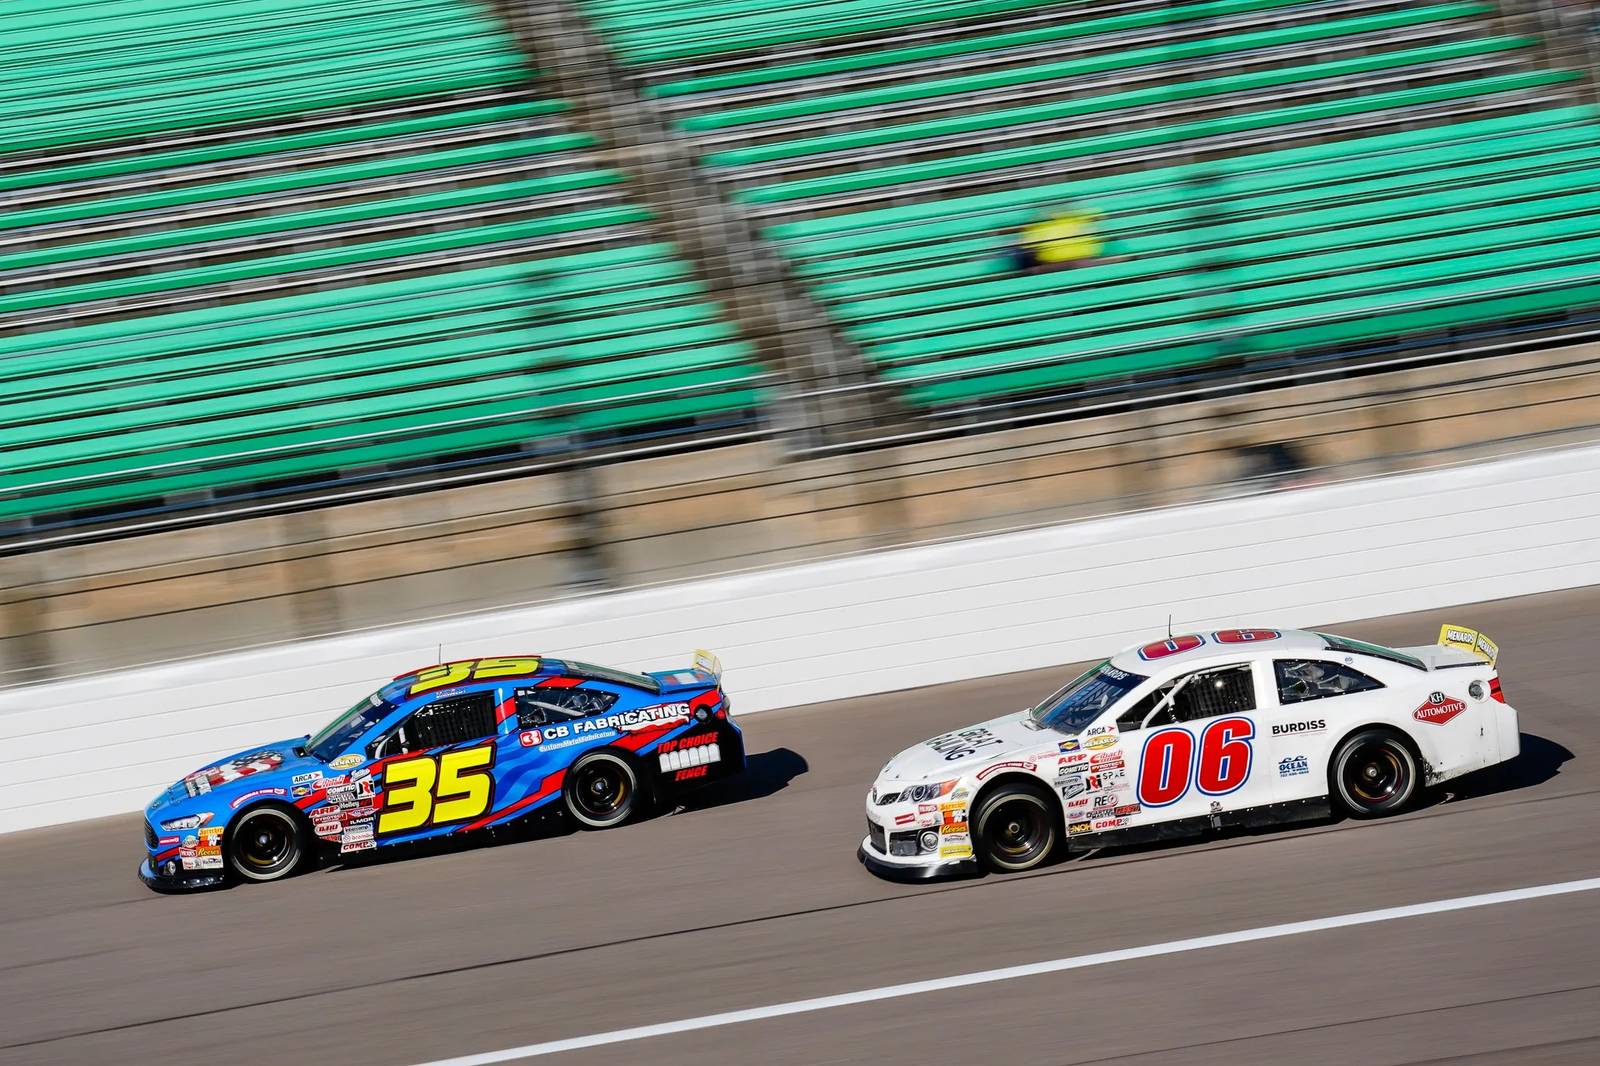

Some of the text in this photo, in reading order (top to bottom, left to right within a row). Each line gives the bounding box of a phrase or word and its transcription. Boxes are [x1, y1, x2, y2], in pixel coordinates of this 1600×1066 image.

[1446, 629, 1475, 644] MENARDS
[1137, 628, 1281, 661] 06
[1477, 636, 1497, 659] MENARDS
[407, 656, 541, 696] 35
[1430, 692, 1443, 703] KH
[1416, 702, 1463, 719] AUTOMOTIVE
[543, 703, 690, 740] CB FABRICATING
[1271, 719, 1327, 735] BURDISS
[1087, 727, 1106, 737] ARCA
[657, 731, 719, 754] TOP CHOICE
[1081, 736, 1119, 749] MENARDS
[1058, 754, 1087, 765] ARP
[1090, 749, 1123, 764] Eibach
[1138, 718, 1255, 807] 06
[1059, 763, 1089, 775] COMETIC
[1279, 761, 1308, 771] OCEAN
[294, 773, 313, 783] ARCA
[675, 765, 709, 782] FENCE
[327, 784, 356, 794] COMETIC
[376, 744, 494, 836] 35
[340, 800, 360, 809] Holley
[310, 806, 339, 817] ARP
[350, 817, 374, 825] ILMOR
[1095, 818, 1123, 829] COMP
[343, 842, 368, 850] COMP
